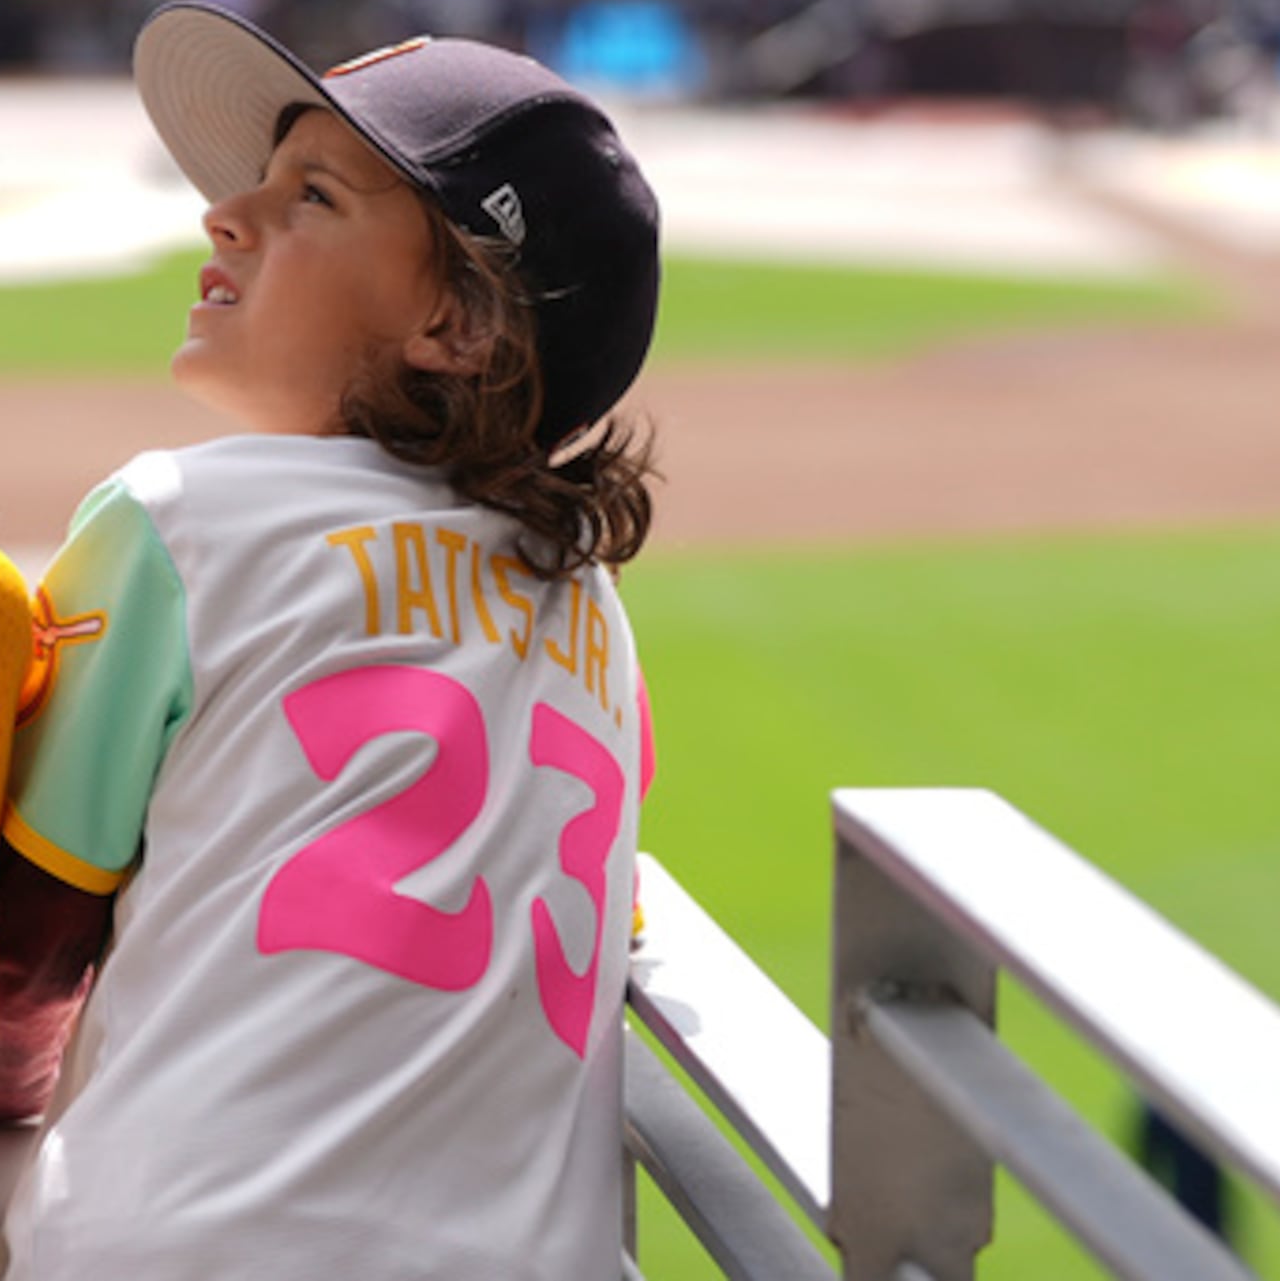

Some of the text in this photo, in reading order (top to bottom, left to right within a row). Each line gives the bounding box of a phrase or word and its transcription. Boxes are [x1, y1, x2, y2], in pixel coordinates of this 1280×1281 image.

[327, 523, 622, 729] TATIS JR.
[256, 665, 625, 1060] 23
